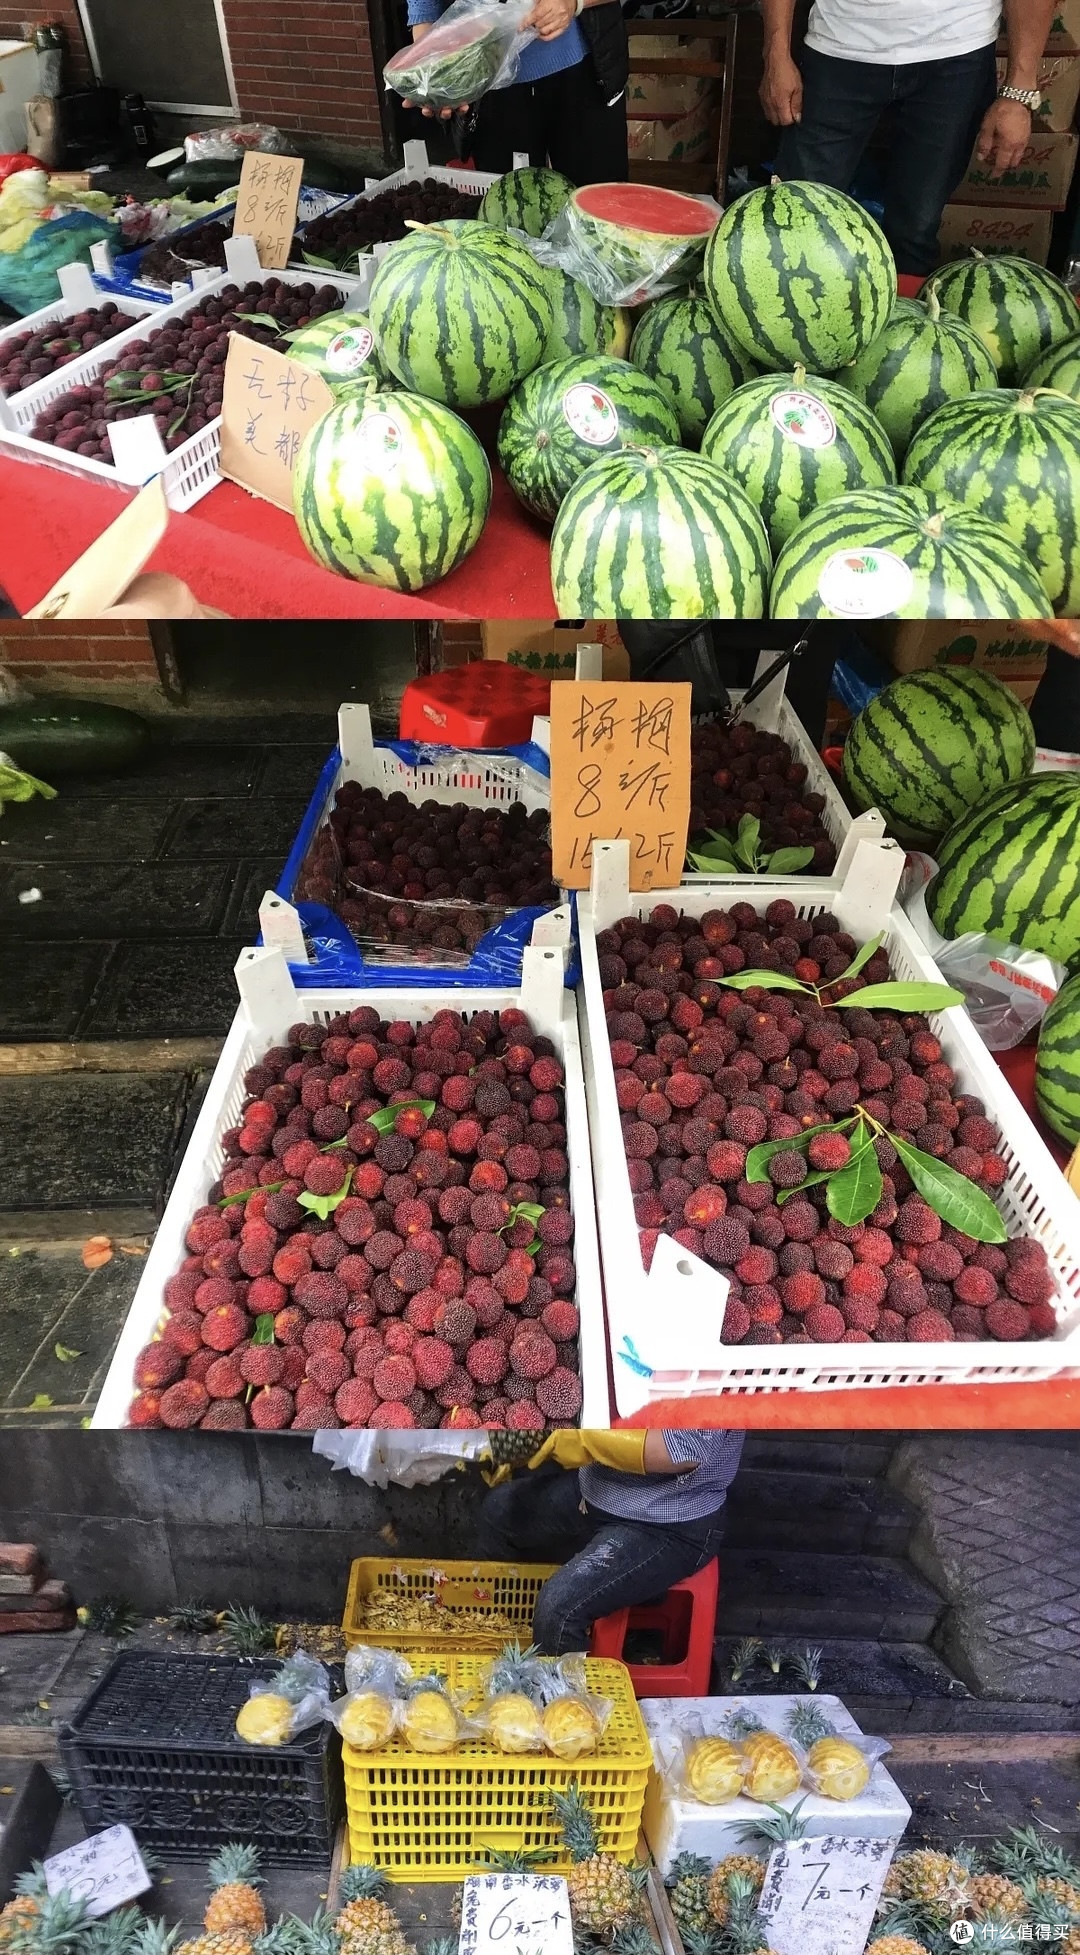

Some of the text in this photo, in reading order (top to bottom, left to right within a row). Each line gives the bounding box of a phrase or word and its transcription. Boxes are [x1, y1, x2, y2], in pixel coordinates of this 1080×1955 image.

[965, 219, 1035, 240] 8424
[801, 1862, 874, 1911] 7元一个
[488, 1897, 568, 1940] 6元一个
